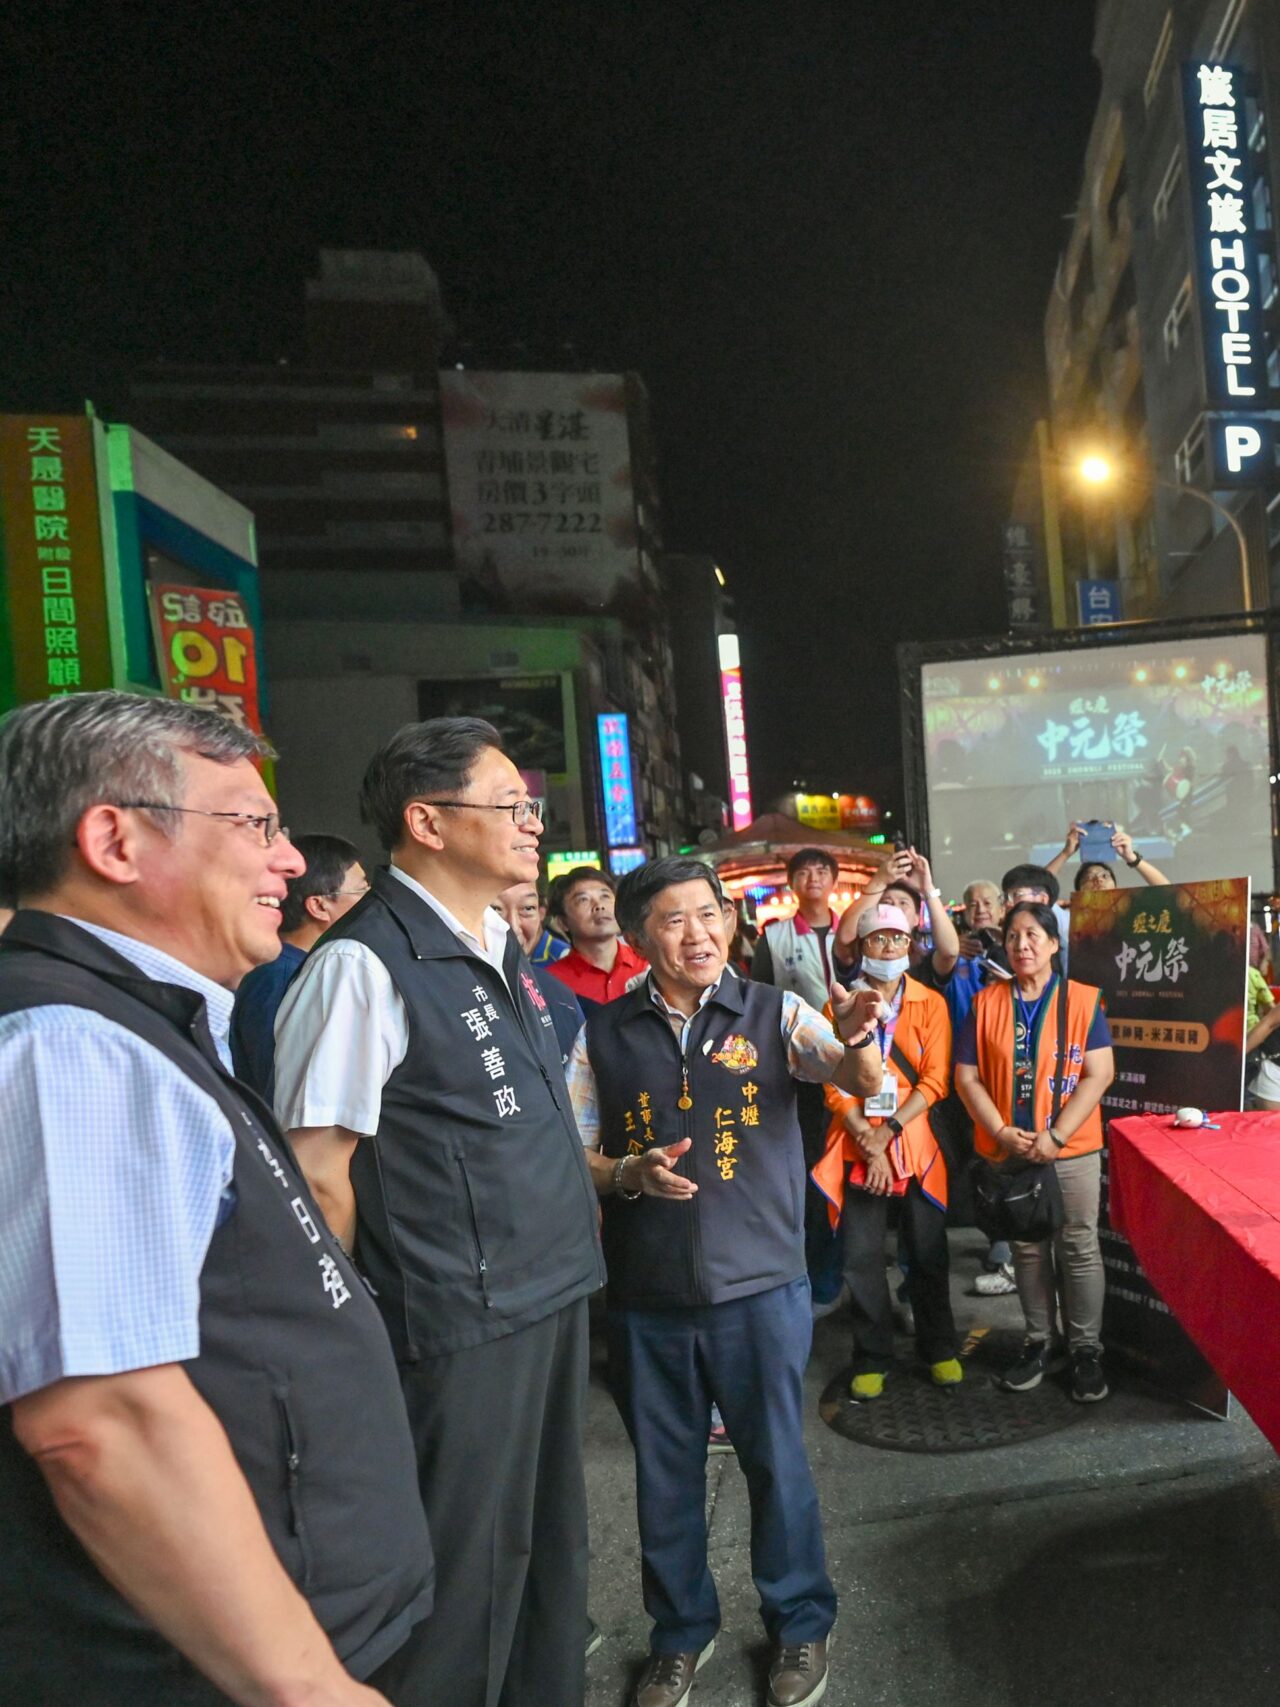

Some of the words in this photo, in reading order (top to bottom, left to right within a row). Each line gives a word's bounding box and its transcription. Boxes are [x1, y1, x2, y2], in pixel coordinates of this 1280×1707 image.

[1197, 64, 1247, 233] 旅居文旅
[1210, 238, 1256, 396] HOTEL
[1225, 425, 1261, 472] P
[1037, 710, 1148, 762] 中元祭
[1115, 936, 1190, 983] 中元祭
[472, 985, 500, 1022] 市長
[461, 1008, 521, 1118] 張善政
[637, 1091, 654, 1141] 董事長
[741, 1081, 760, 1126] 中壢
[714, 1107, 737, 1181] 仁海宮
